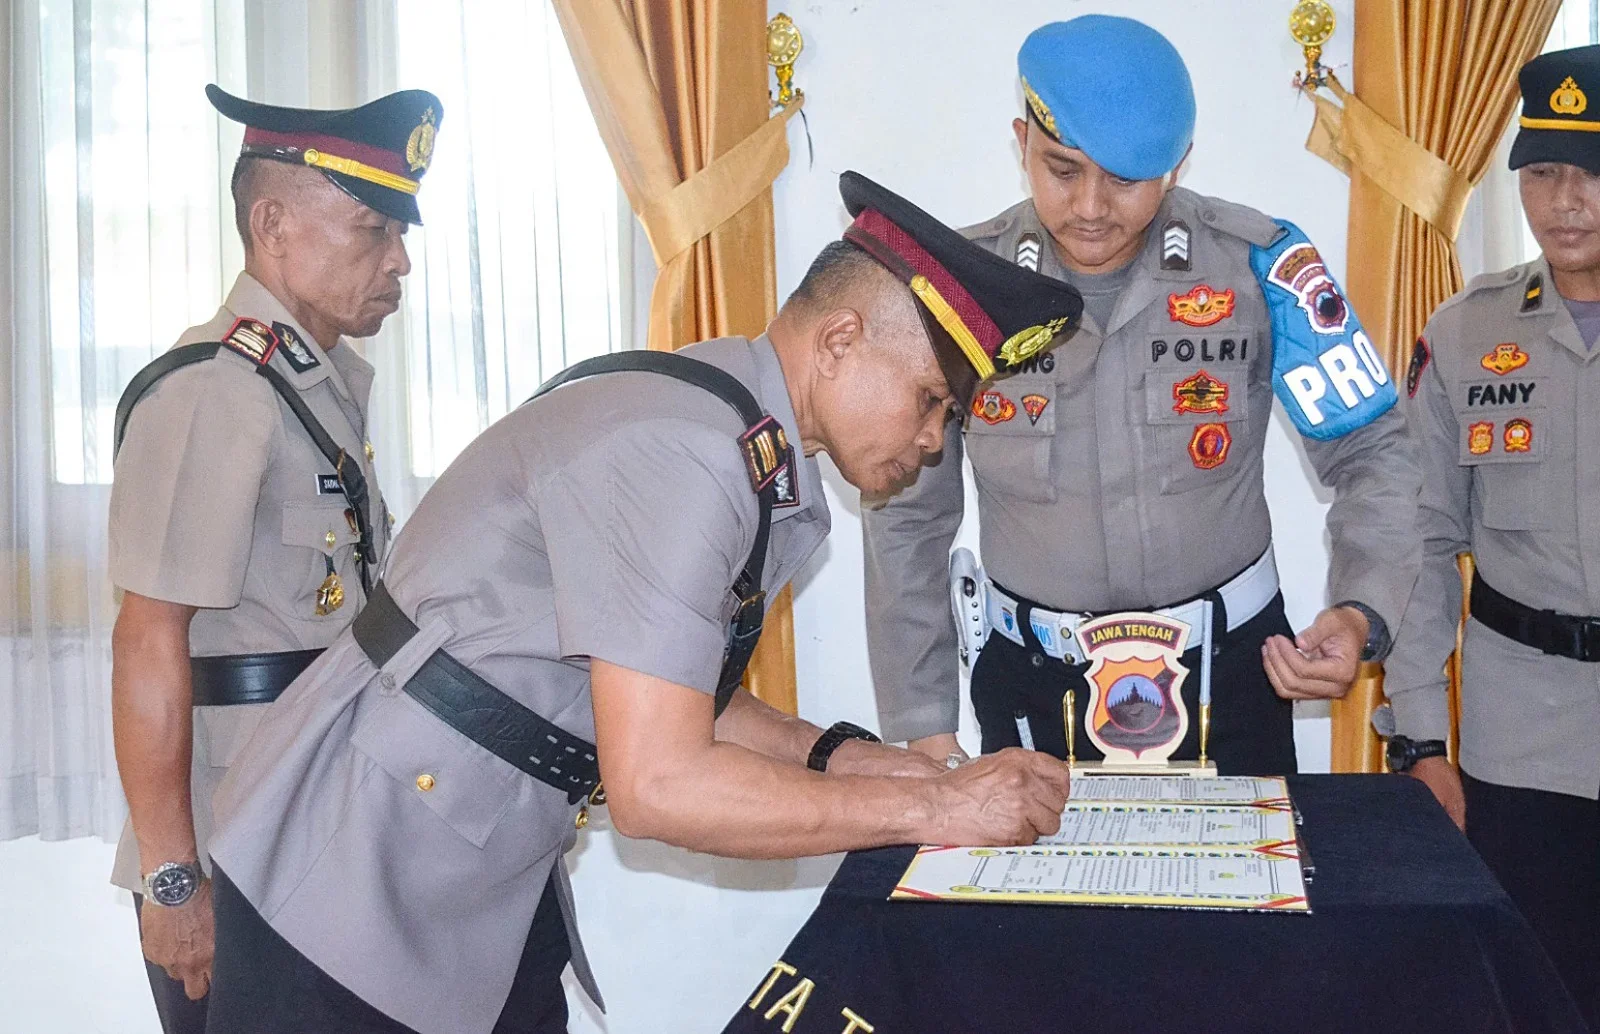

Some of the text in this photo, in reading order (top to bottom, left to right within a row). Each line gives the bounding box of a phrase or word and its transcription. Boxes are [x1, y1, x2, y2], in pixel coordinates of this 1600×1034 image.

[1152, 339, 1248, 363] POLRI
[1282, 330, 1388, 426] PRO
[1468, 382, 1536, 407] FANY
[1091, 624, 1174, 644] JAWA TENGAH
[749, 960, 816, 1034] TA
